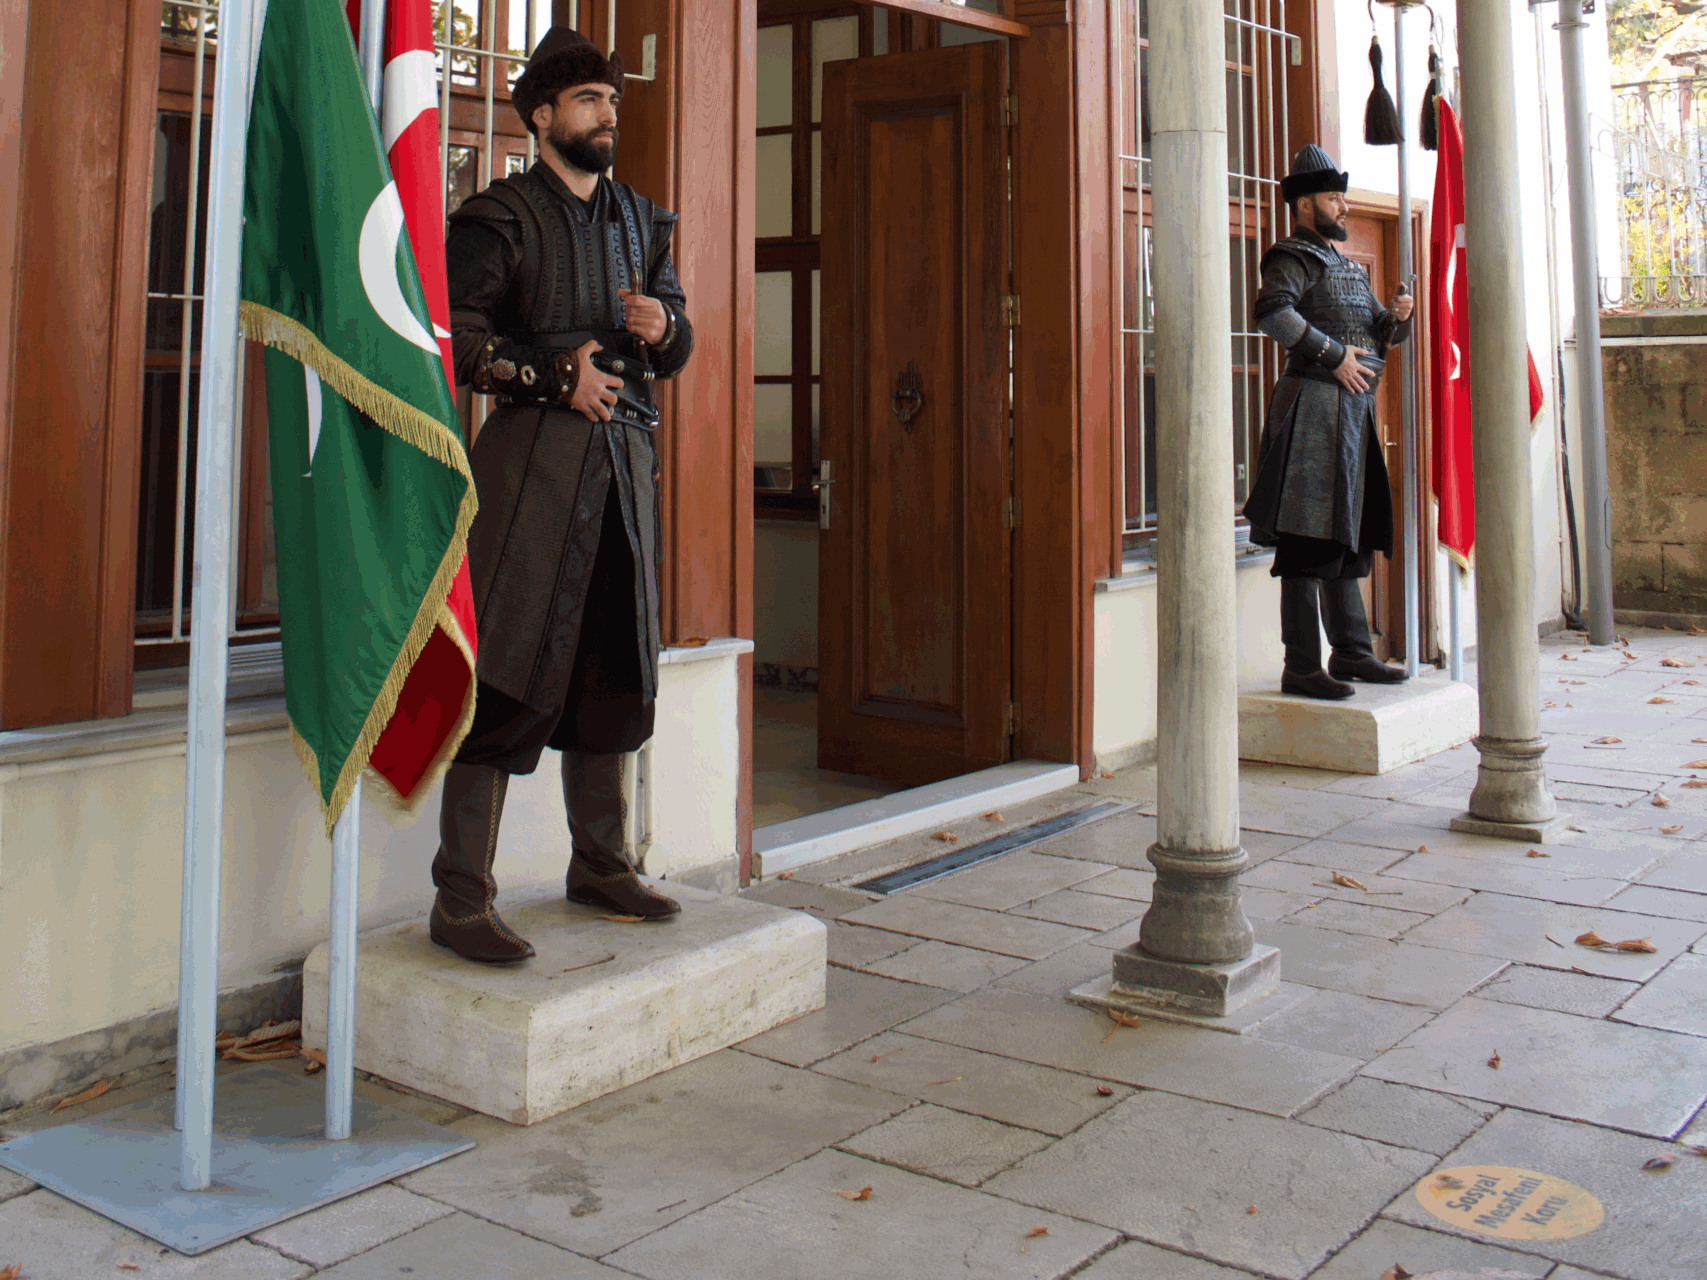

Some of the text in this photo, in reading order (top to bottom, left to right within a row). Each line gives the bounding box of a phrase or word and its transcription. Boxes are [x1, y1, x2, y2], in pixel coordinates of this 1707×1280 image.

[1445, 1174, 1502, 1212] Sosyal
[1473, 1175, 1544, 1229] Mesafeni
[1520, 1195, 1569, 1226] Koru
